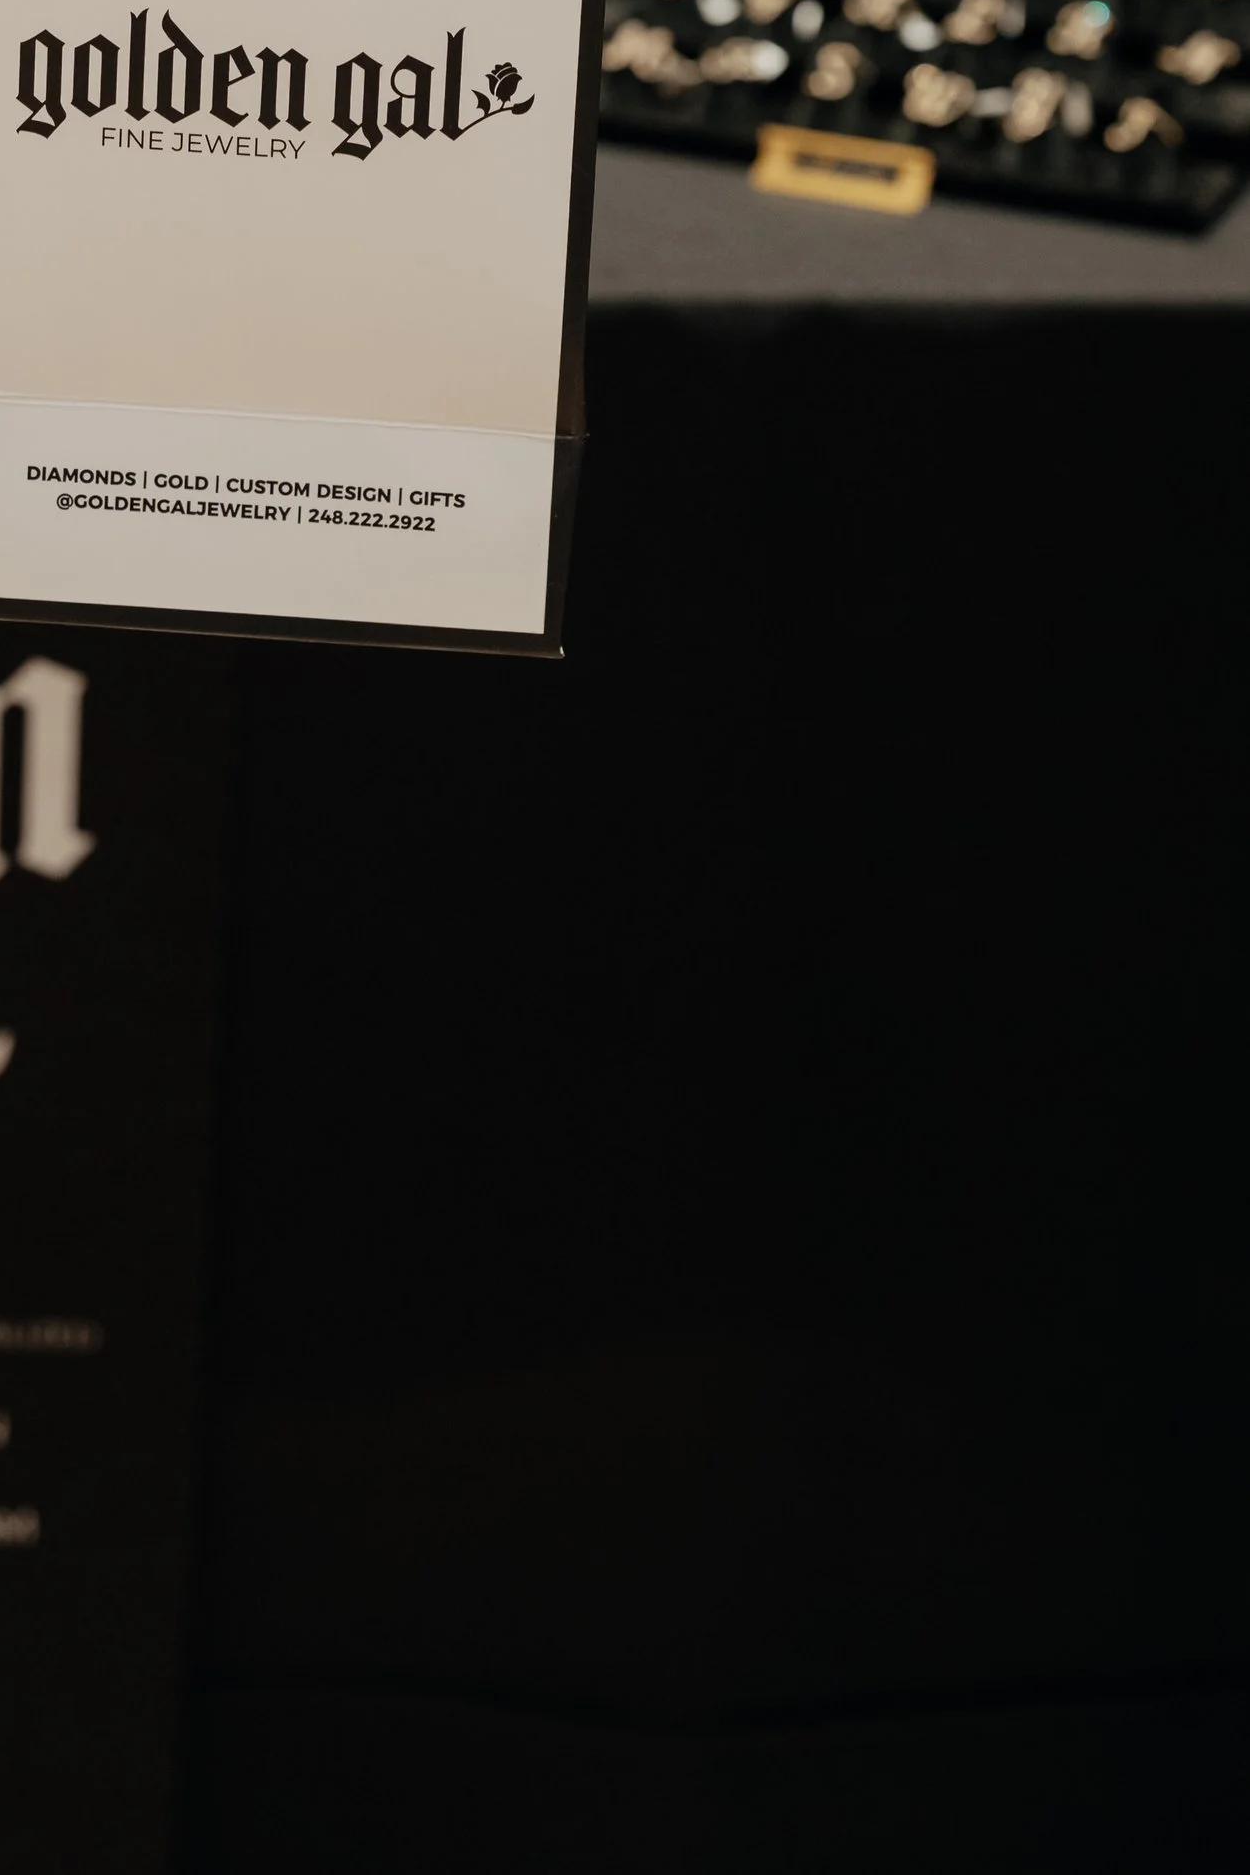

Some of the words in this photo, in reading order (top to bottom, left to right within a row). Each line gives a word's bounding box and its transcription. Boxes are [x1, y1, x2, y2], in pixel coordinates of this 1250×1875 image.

[15, 7, 313, 139] golden
[330, 26, 466, 162] gal
[101, 127, 165, 152] FINE
[171, 132, 307, 160] JEWELRY
[26, 465, 138, 487] DIAMONDS
[153, 473, 210, 491] GOLD
[226, 477, 311, 498] CUSTOM
[317, 483, 393, 504] DESIGN
[409, 490, 467, 509] GIFTS
[56, 493, 292, 522] @GOLDENGALJEWELRY
[308, 508, 437, 532] 248.222.2922
